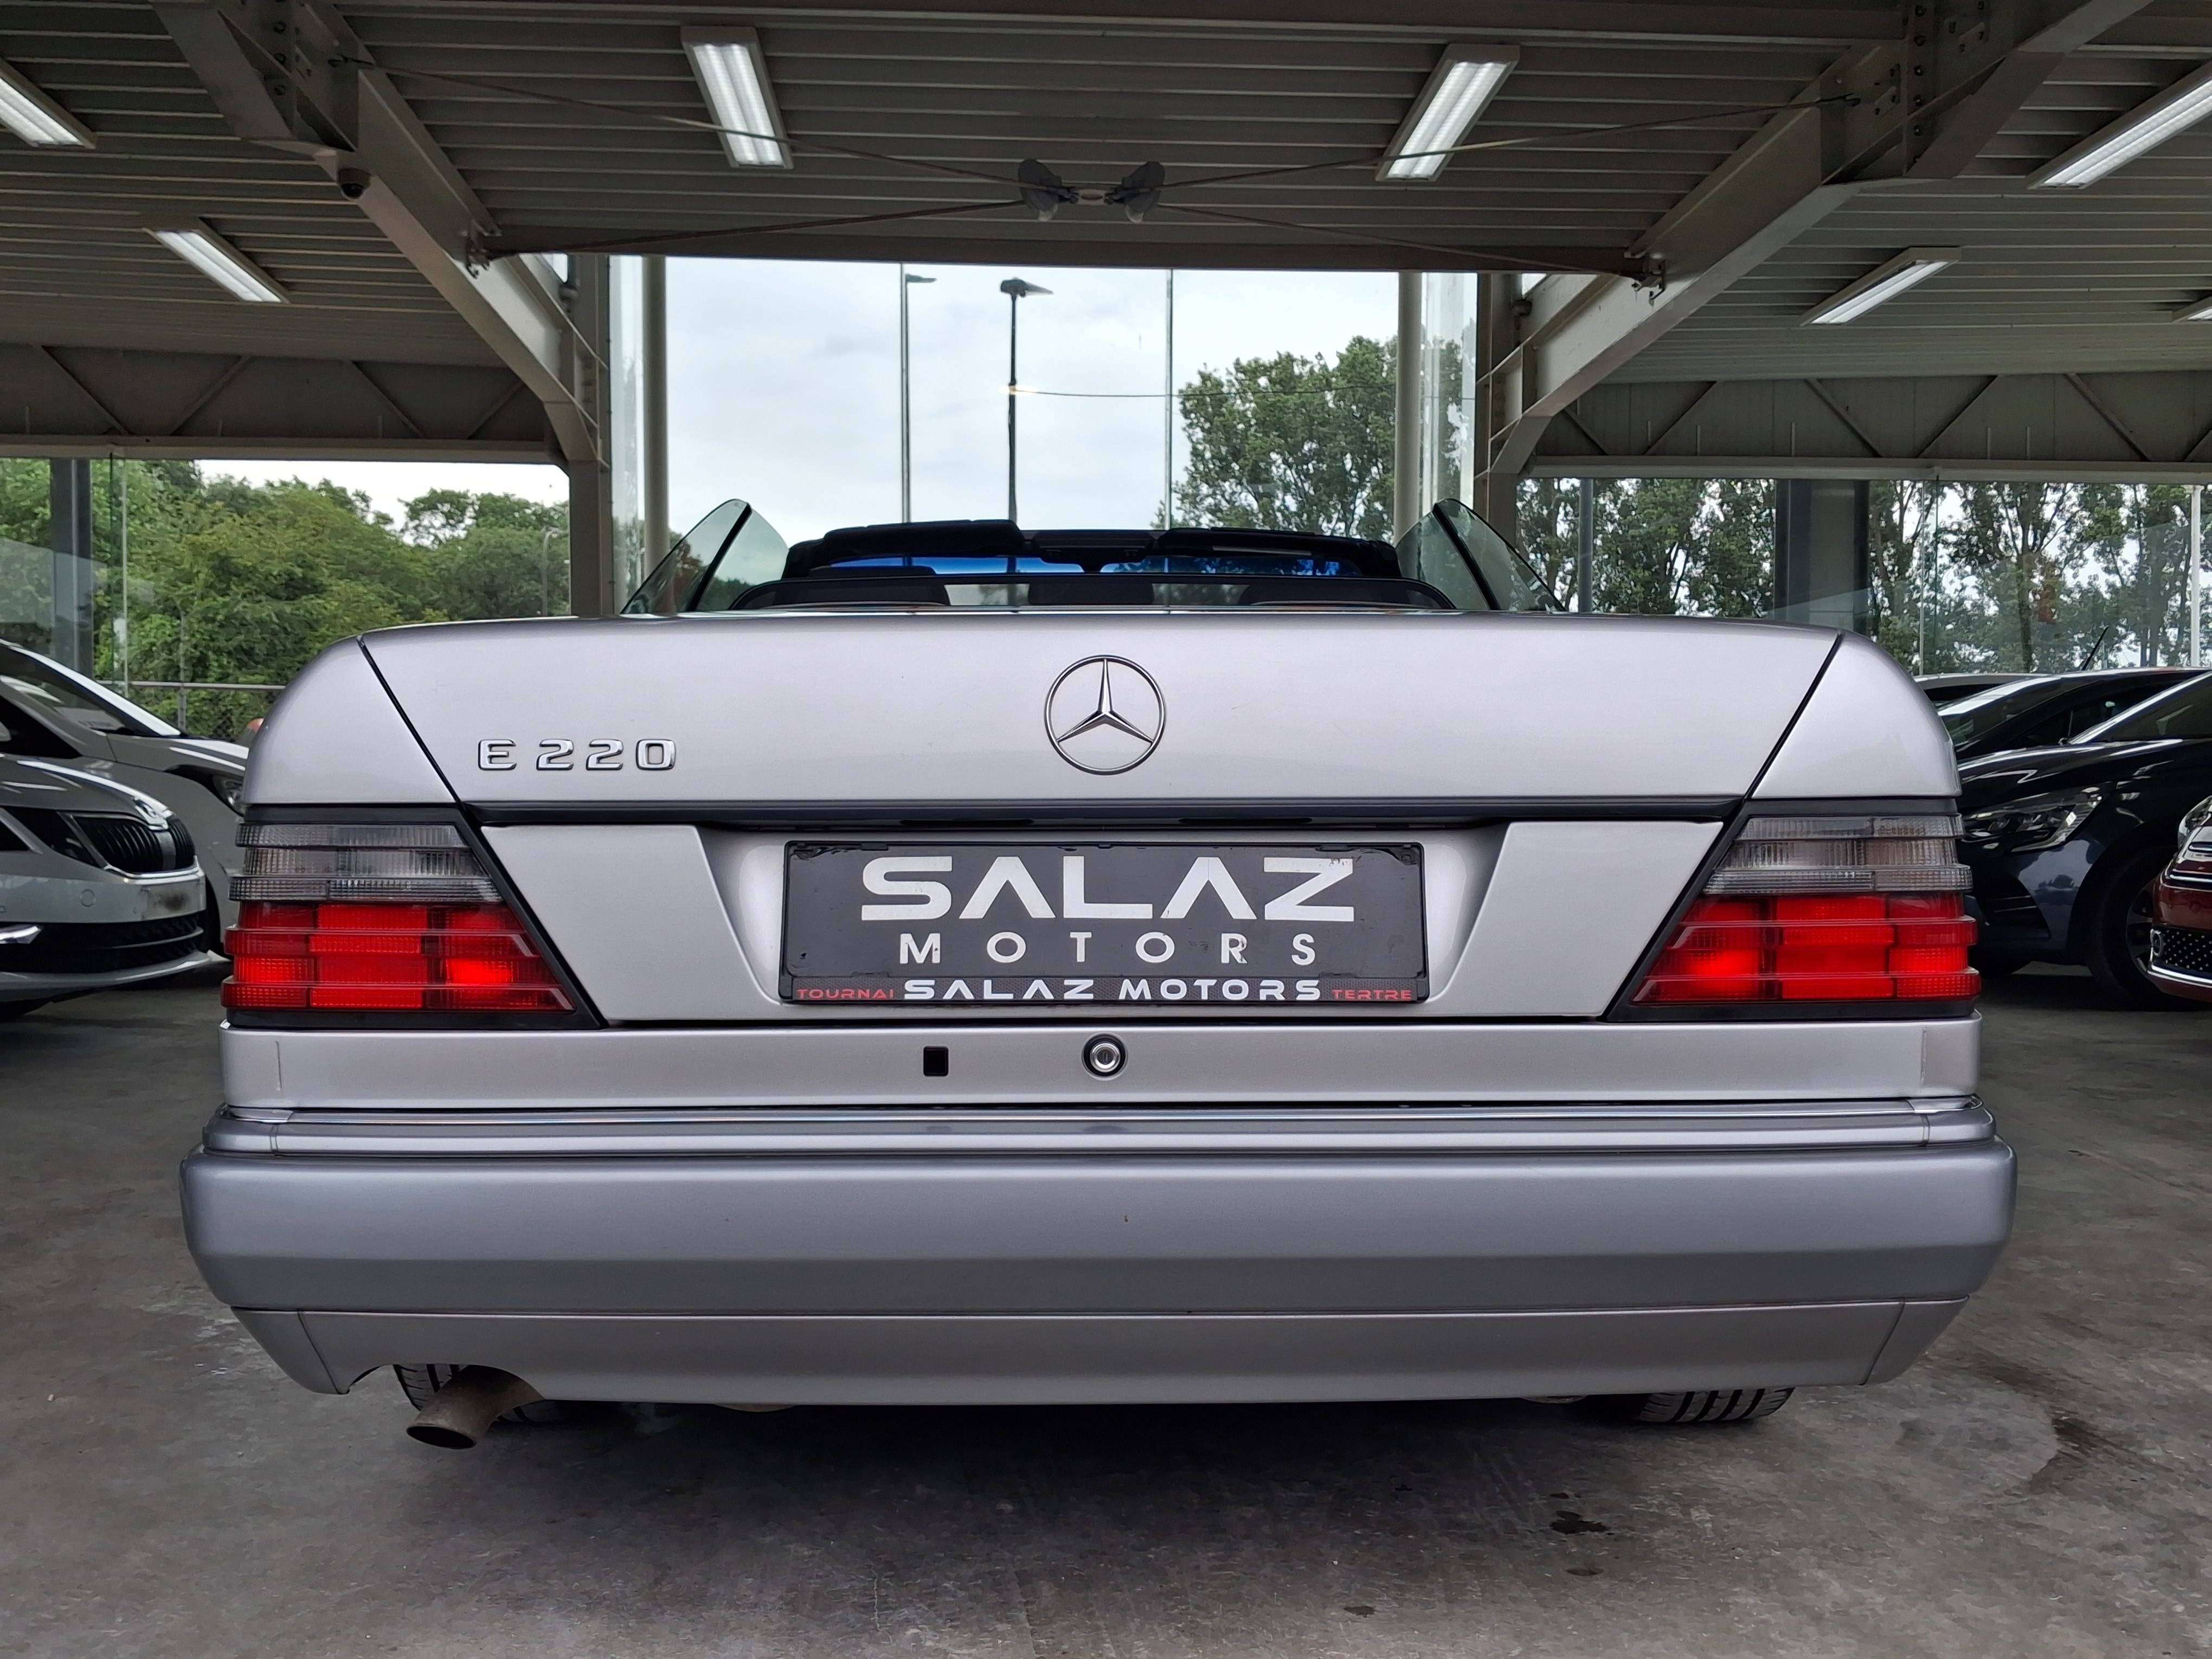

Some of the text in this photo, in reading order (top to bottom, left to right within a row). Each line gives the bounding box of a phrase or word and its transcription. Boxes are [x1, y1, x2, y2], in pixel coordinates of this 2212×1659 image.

[478, 739, 677, 770] E 220
[861, 856, 1355, 921] SALAZ
[899, 932, 1316, 966] MOTORS
[797, 979, 1412, 1001] TOURNAI SALAZ MOTORS TERTRE
